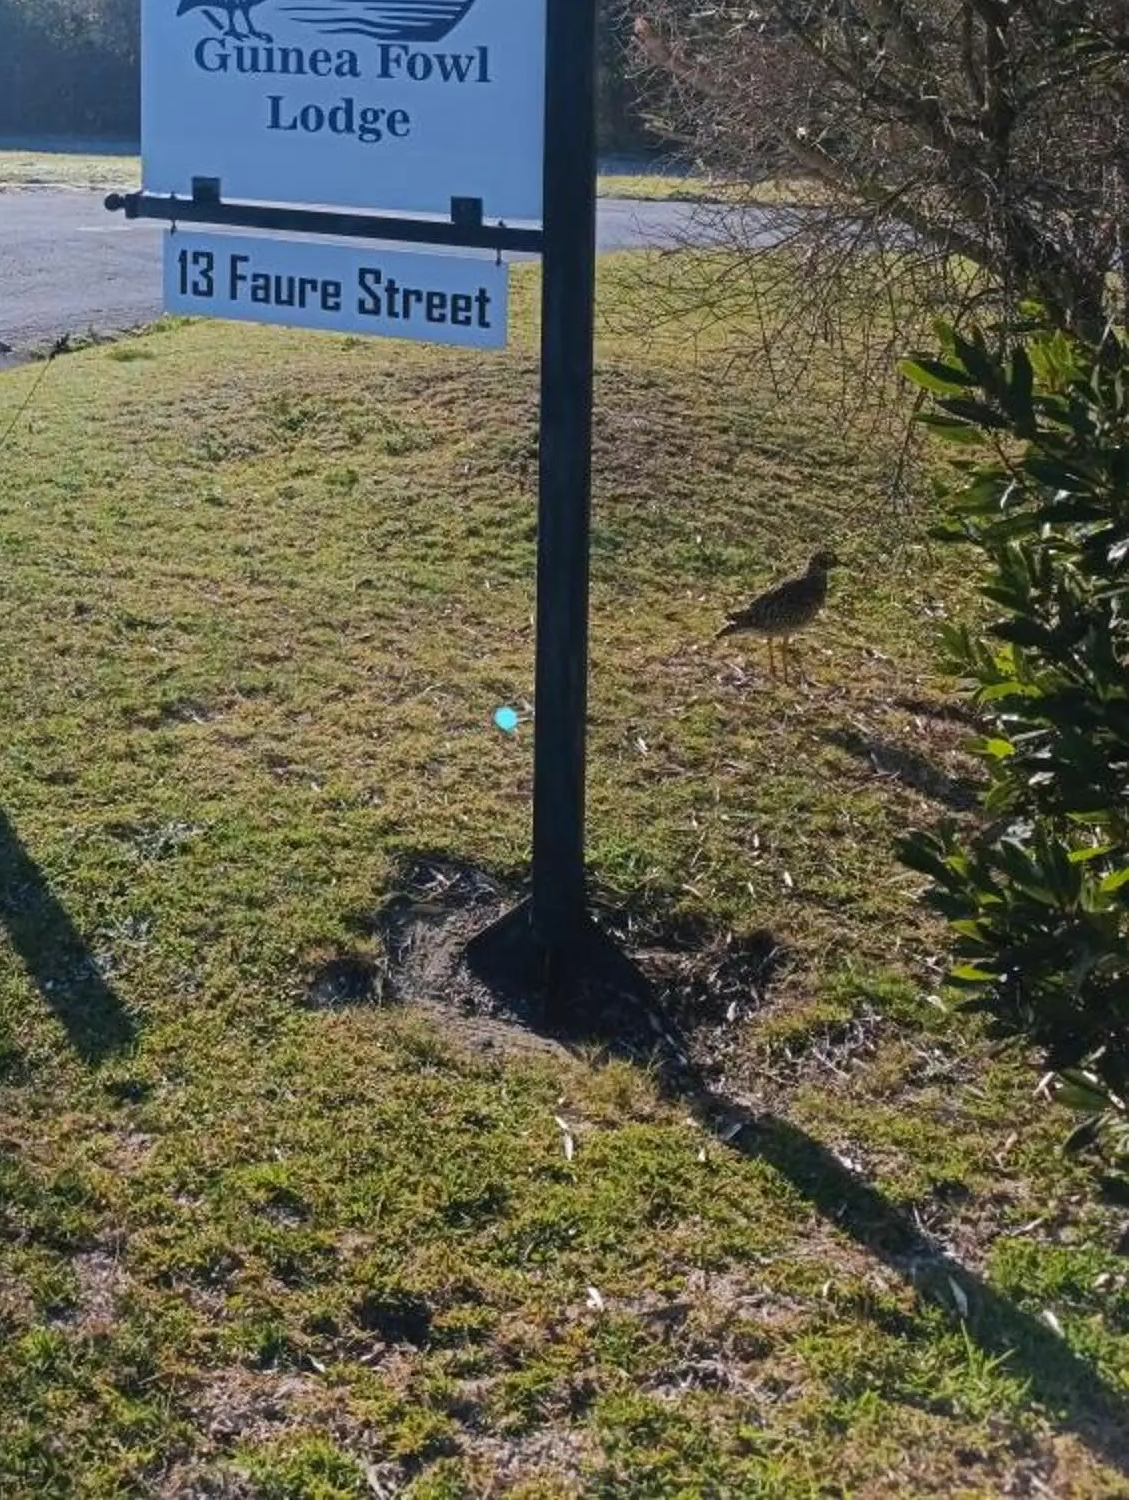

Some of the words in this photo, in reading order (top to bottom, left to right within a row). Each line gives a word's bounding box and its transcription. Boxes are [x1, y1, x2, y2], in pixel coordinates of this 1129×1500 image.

[194, 37, 361, 79] Guinea
[376, 43, 491, 83] Fowl
[267, 95, 411, 143] Lodge
[178, 249, 214, 297] 13
[230, 254, 342, 312] Faure
[358, 267, 491, 329] Street
